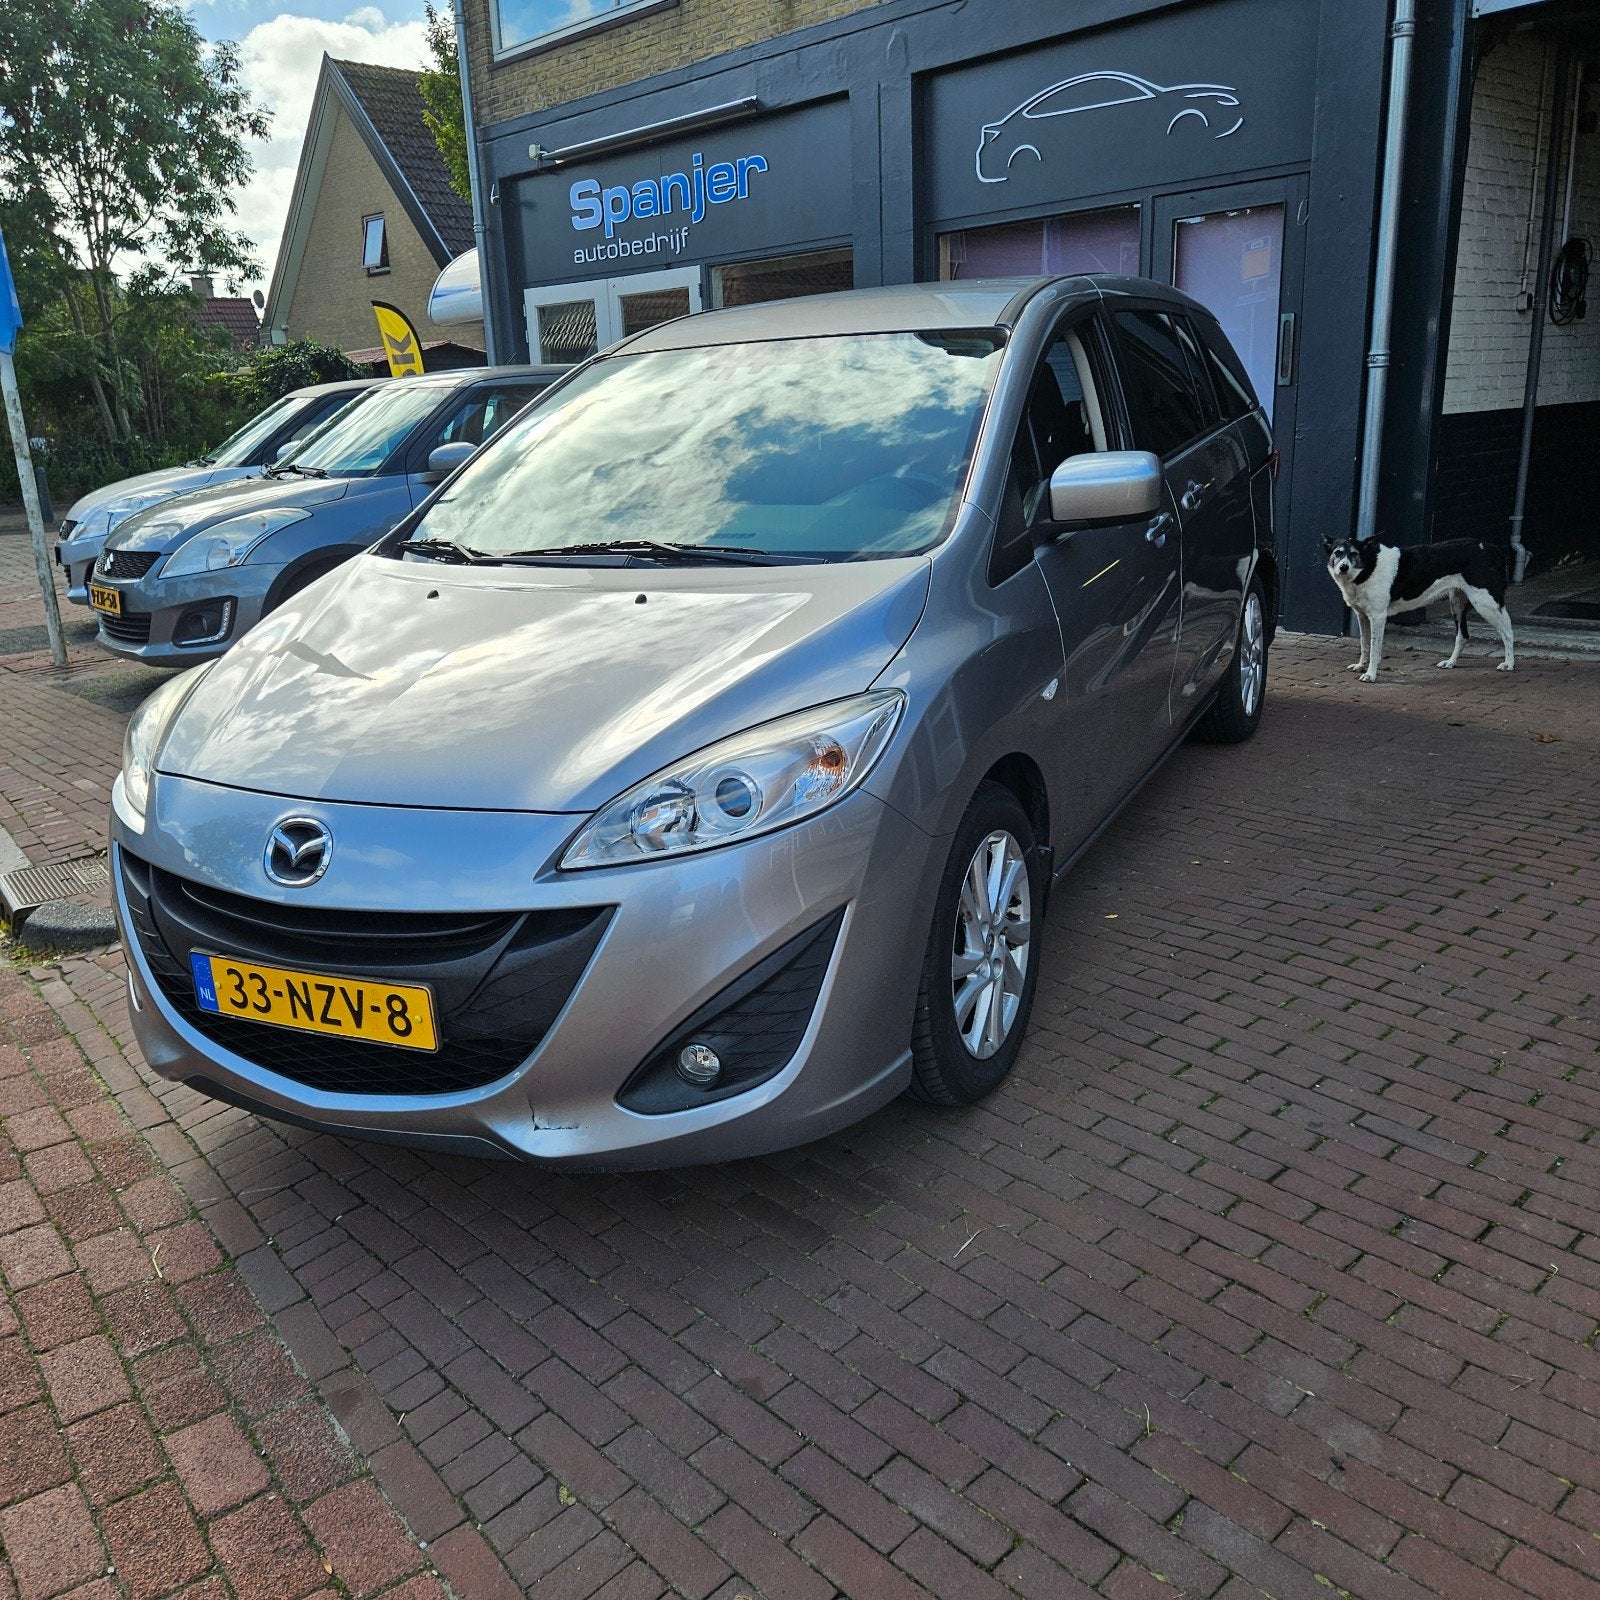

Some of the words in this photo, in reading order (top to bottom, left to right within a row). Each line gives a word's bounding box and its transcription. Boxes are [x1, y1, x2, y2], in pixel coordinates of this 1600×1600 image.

[569, 152, 769, 239] Spanjer
[574, 226, 689, 264] autobedrijf
[199, 986, 215, 1002] NL
[226, 968, 413, 1038] 33-NZV-8
